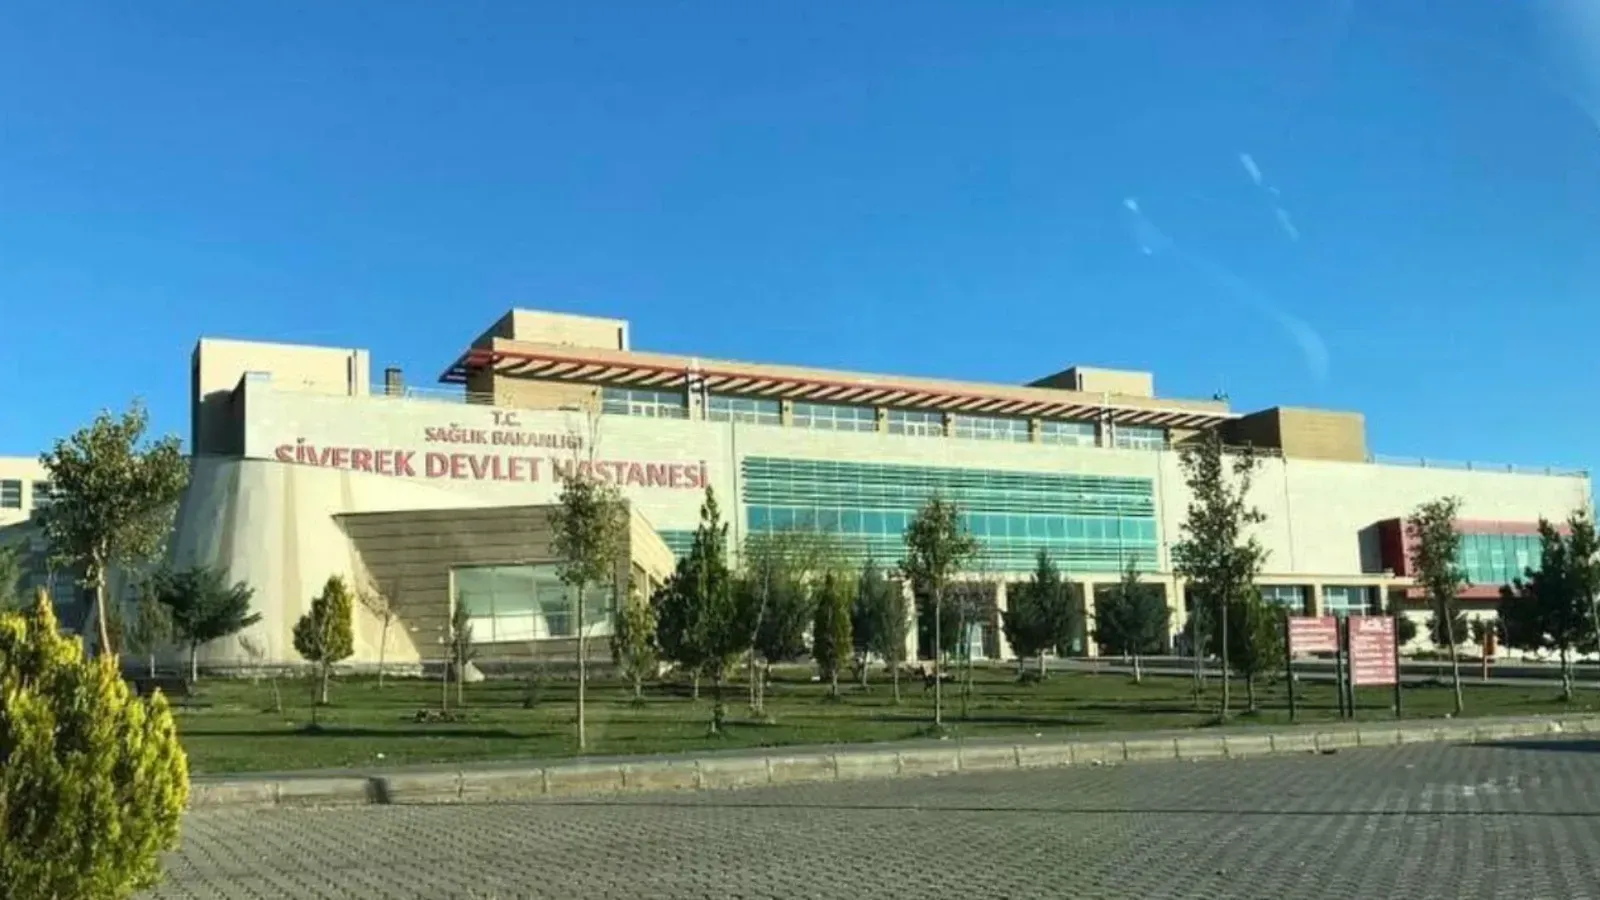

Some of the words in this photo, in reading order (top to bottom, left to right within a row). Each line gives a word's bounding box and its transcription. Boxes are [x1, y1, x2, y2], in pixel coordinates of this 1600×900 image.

[491, 411, 521, 426] T.C.
[425, 423, 488, 444] SAĞLIK
[491, 430, 583, 449] BAKANLIĞI
[275, 437, 416, 477] SİVEREK
[425, 452, 543, 482] DEVLET
[552, 458, 707, 488] HASTANESİ
